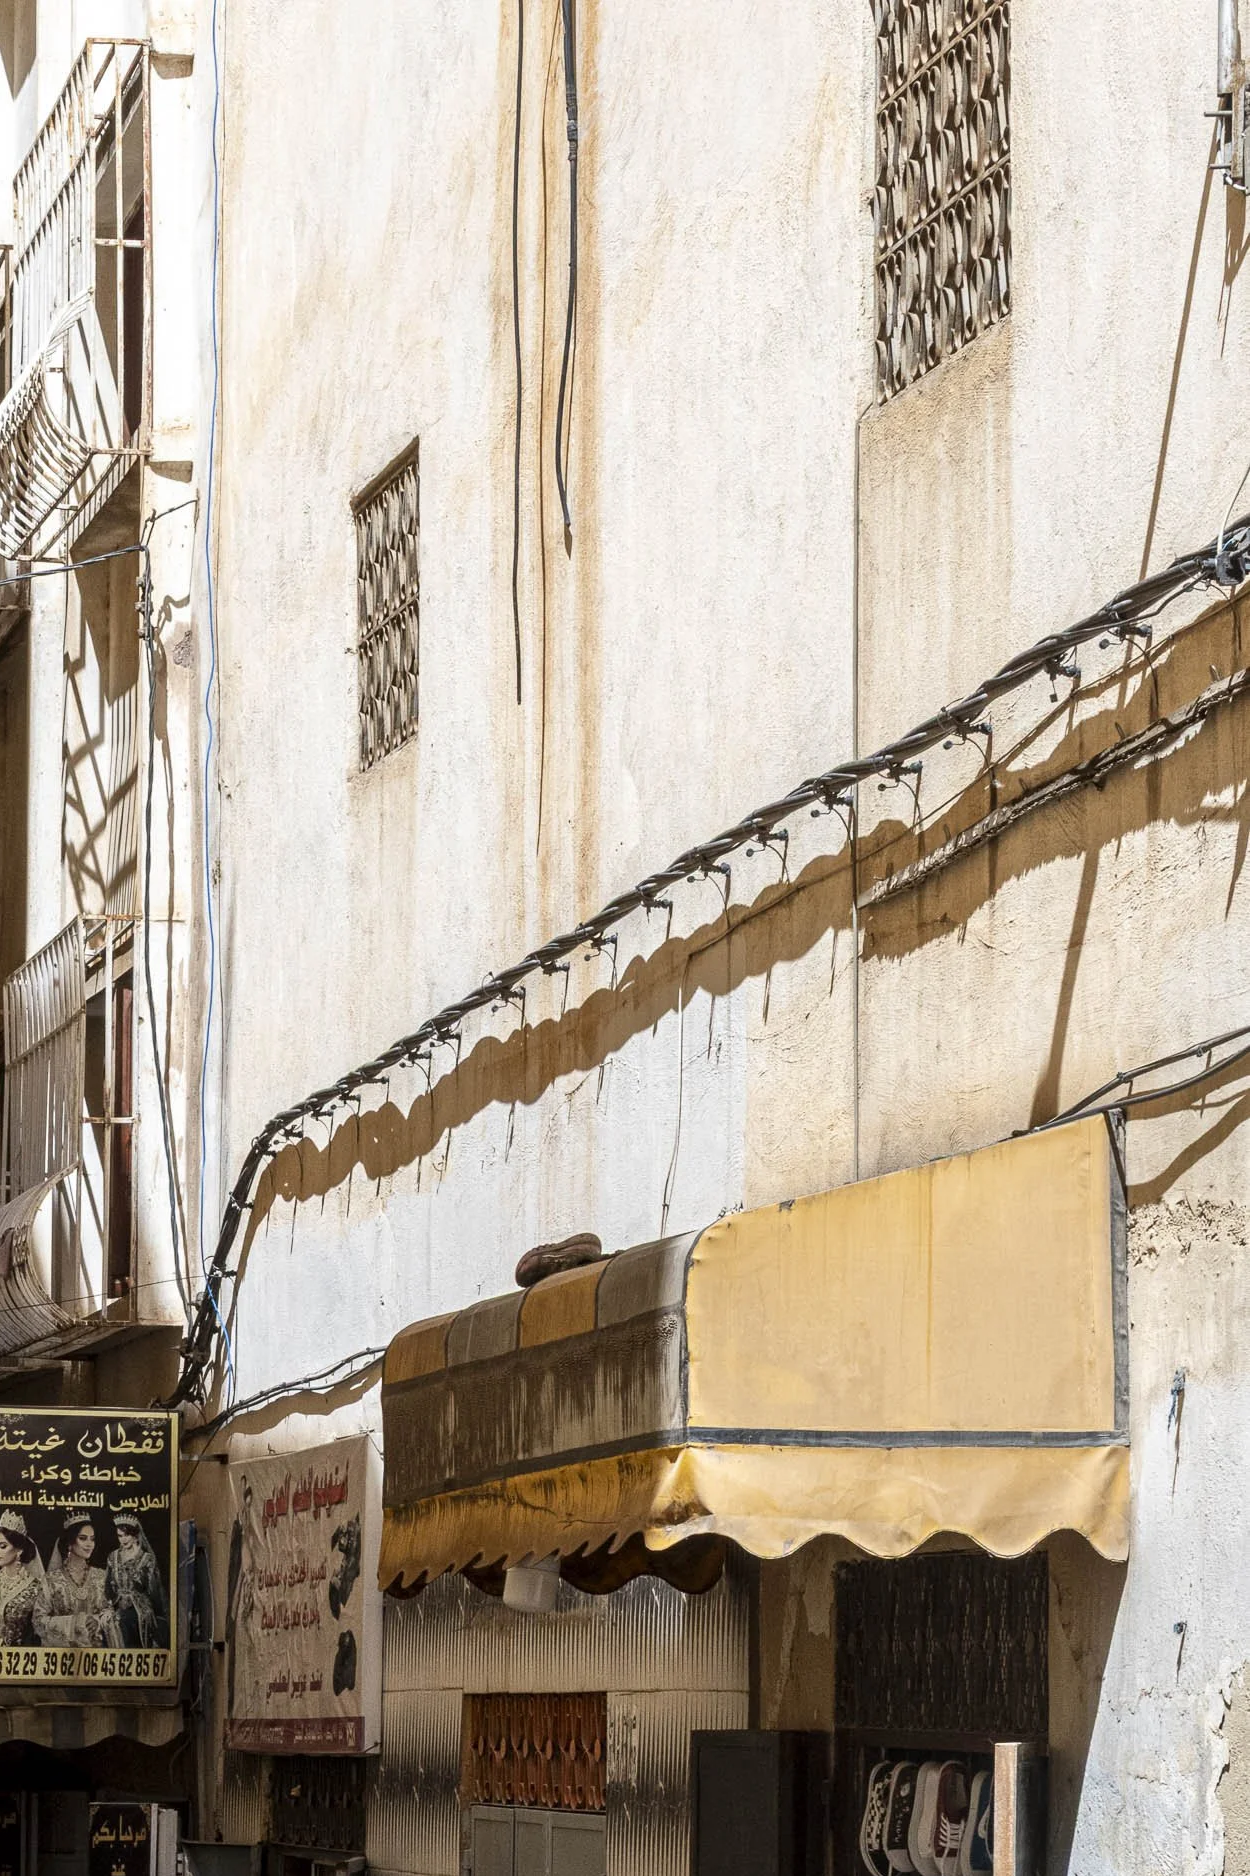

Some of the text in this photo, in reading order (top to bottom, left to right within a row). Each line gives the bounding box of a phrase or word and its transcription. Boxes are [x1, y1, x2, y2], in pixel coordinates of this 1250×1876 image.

[77, 1422, 165, 1458] قفطان
[21, 1463, 142, 1486] خياطة وكراء
[37, 1490, 104, 1510] التقليدية
[109, 1493, 170, 1512] الملابس
[5, 1651, 20, 1675] 32
[22, 1651, 38, 1675] 29
[43, 1652, 58, 1676] 39
[101, 1653, 116, 1677] 45
[118, 1653, 133, 1677] 62
[135, 1653, 150, 1677] 85
[152, 1653, 167, 1677] 67
